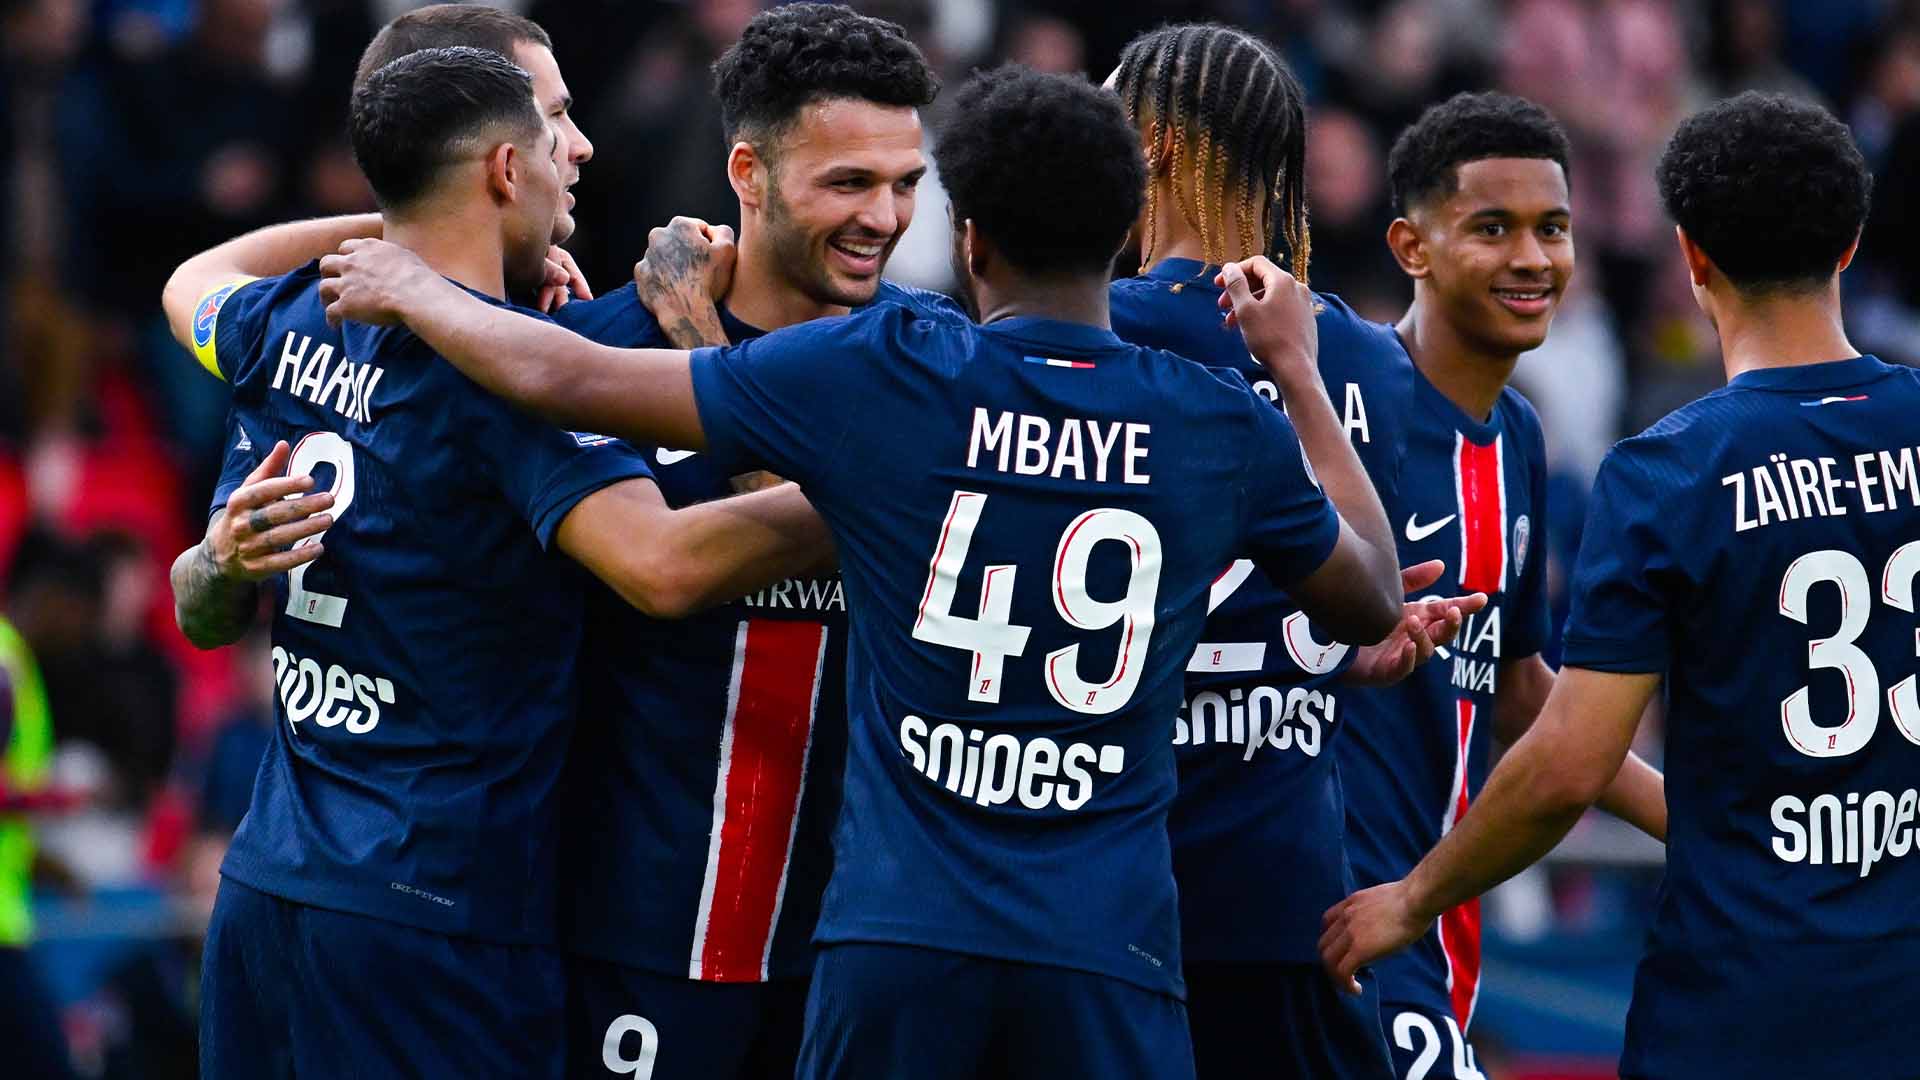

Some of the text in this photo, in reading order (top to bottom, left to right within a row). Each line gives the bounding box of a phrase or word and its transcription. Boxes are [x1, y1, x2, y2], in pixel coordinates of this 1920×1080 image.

[967, 407, 1150, 484] MBAYE
[1721, 446, 1920, 532] ZAÏRE-EM
[912, 490, 1162, 714] 49
[900, 714, 1097, 811] snipes
[1770, 788, 1920, 878] snipe
[602, 1014, 659, 1080] 9
[1393, 1012, 1487, 1080] 24
